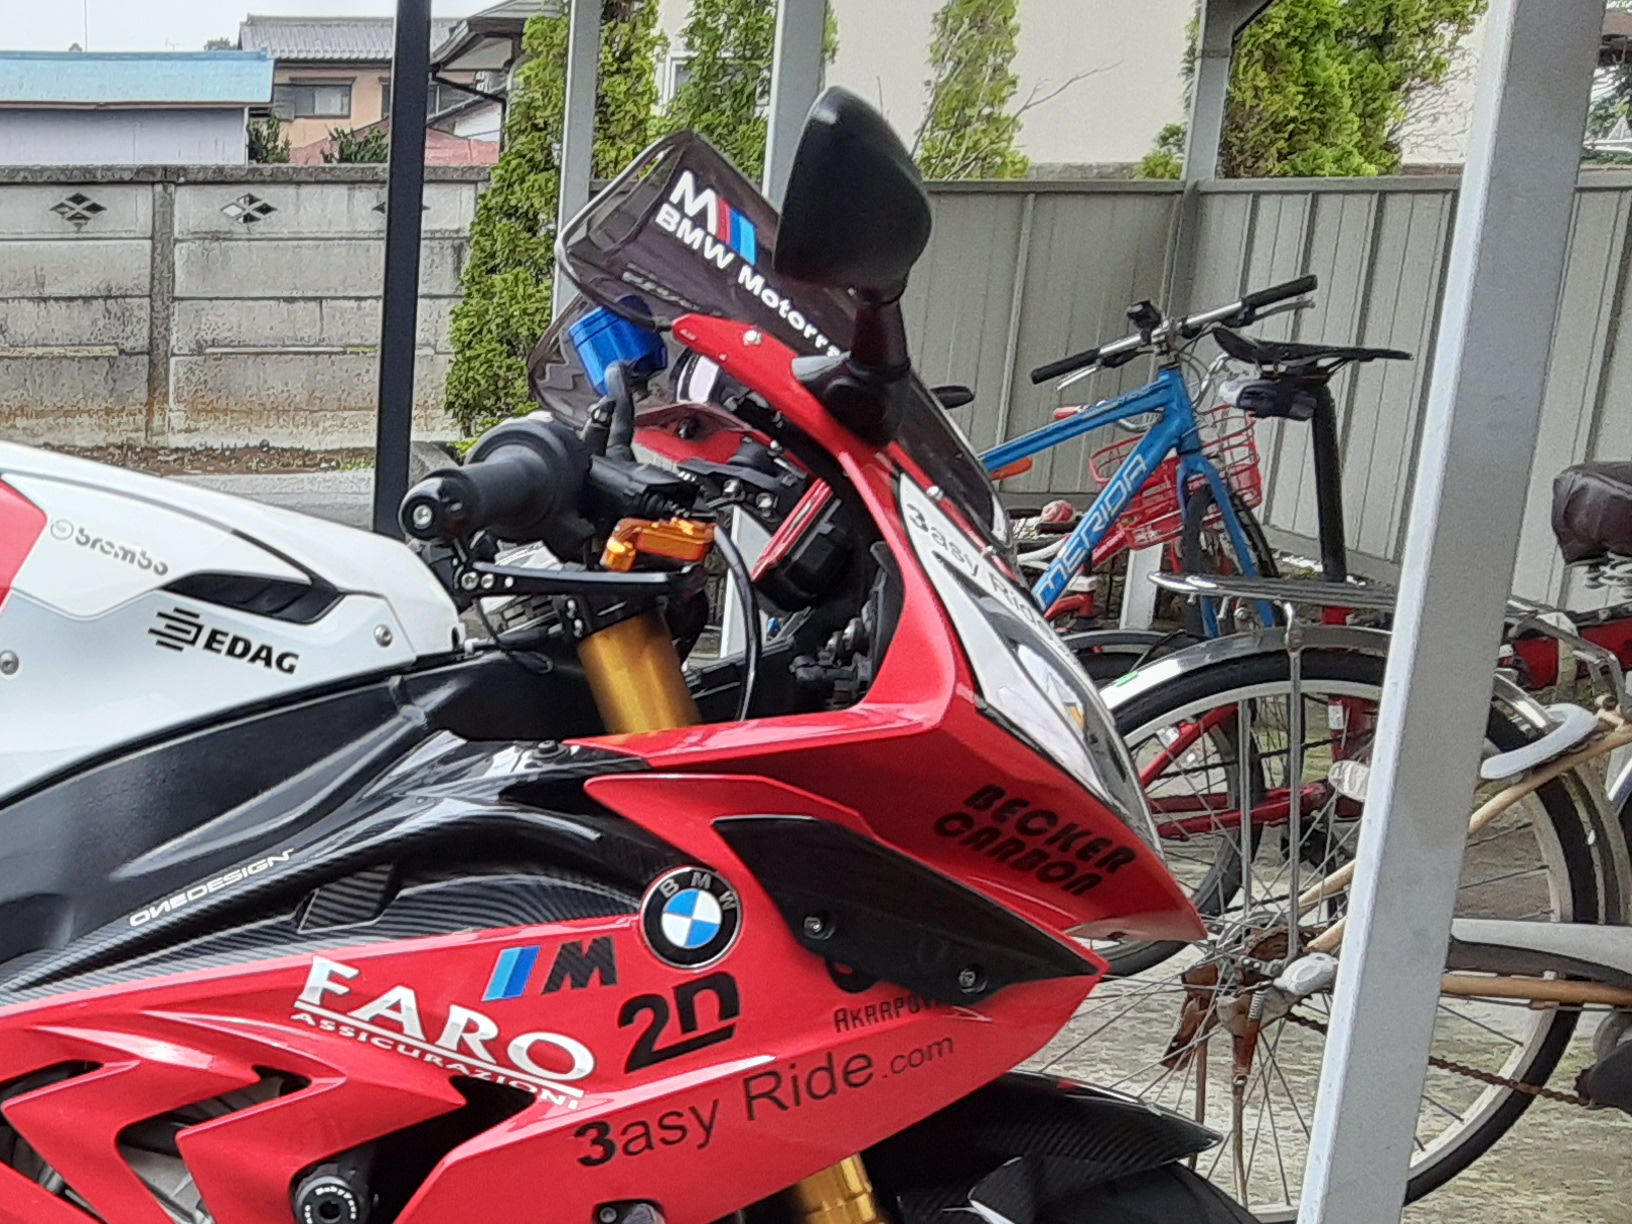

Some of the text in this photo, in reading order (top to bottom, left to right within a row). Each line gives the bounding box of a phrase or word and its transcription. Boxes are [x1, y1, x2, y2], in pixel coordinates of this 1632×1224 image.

[655, 202, 735, 270] BMW
[737, 264, 842, 359] Motorra
[74, 526, 169, 577] brembo
[203, 628, 300, 675] EDAG
[962, 784, 1137, 875] BECKER
[128, 848, 295, 927] ONEDESIGN
[658, 870, 737, 911] BMW
[541, 935, 618, 995] M
[294, 955, 595, 1082] FARO
[289, 1011, 580, 1111] ASSICURAZIONI
[574, 1098, 720, 1167] 3asy
